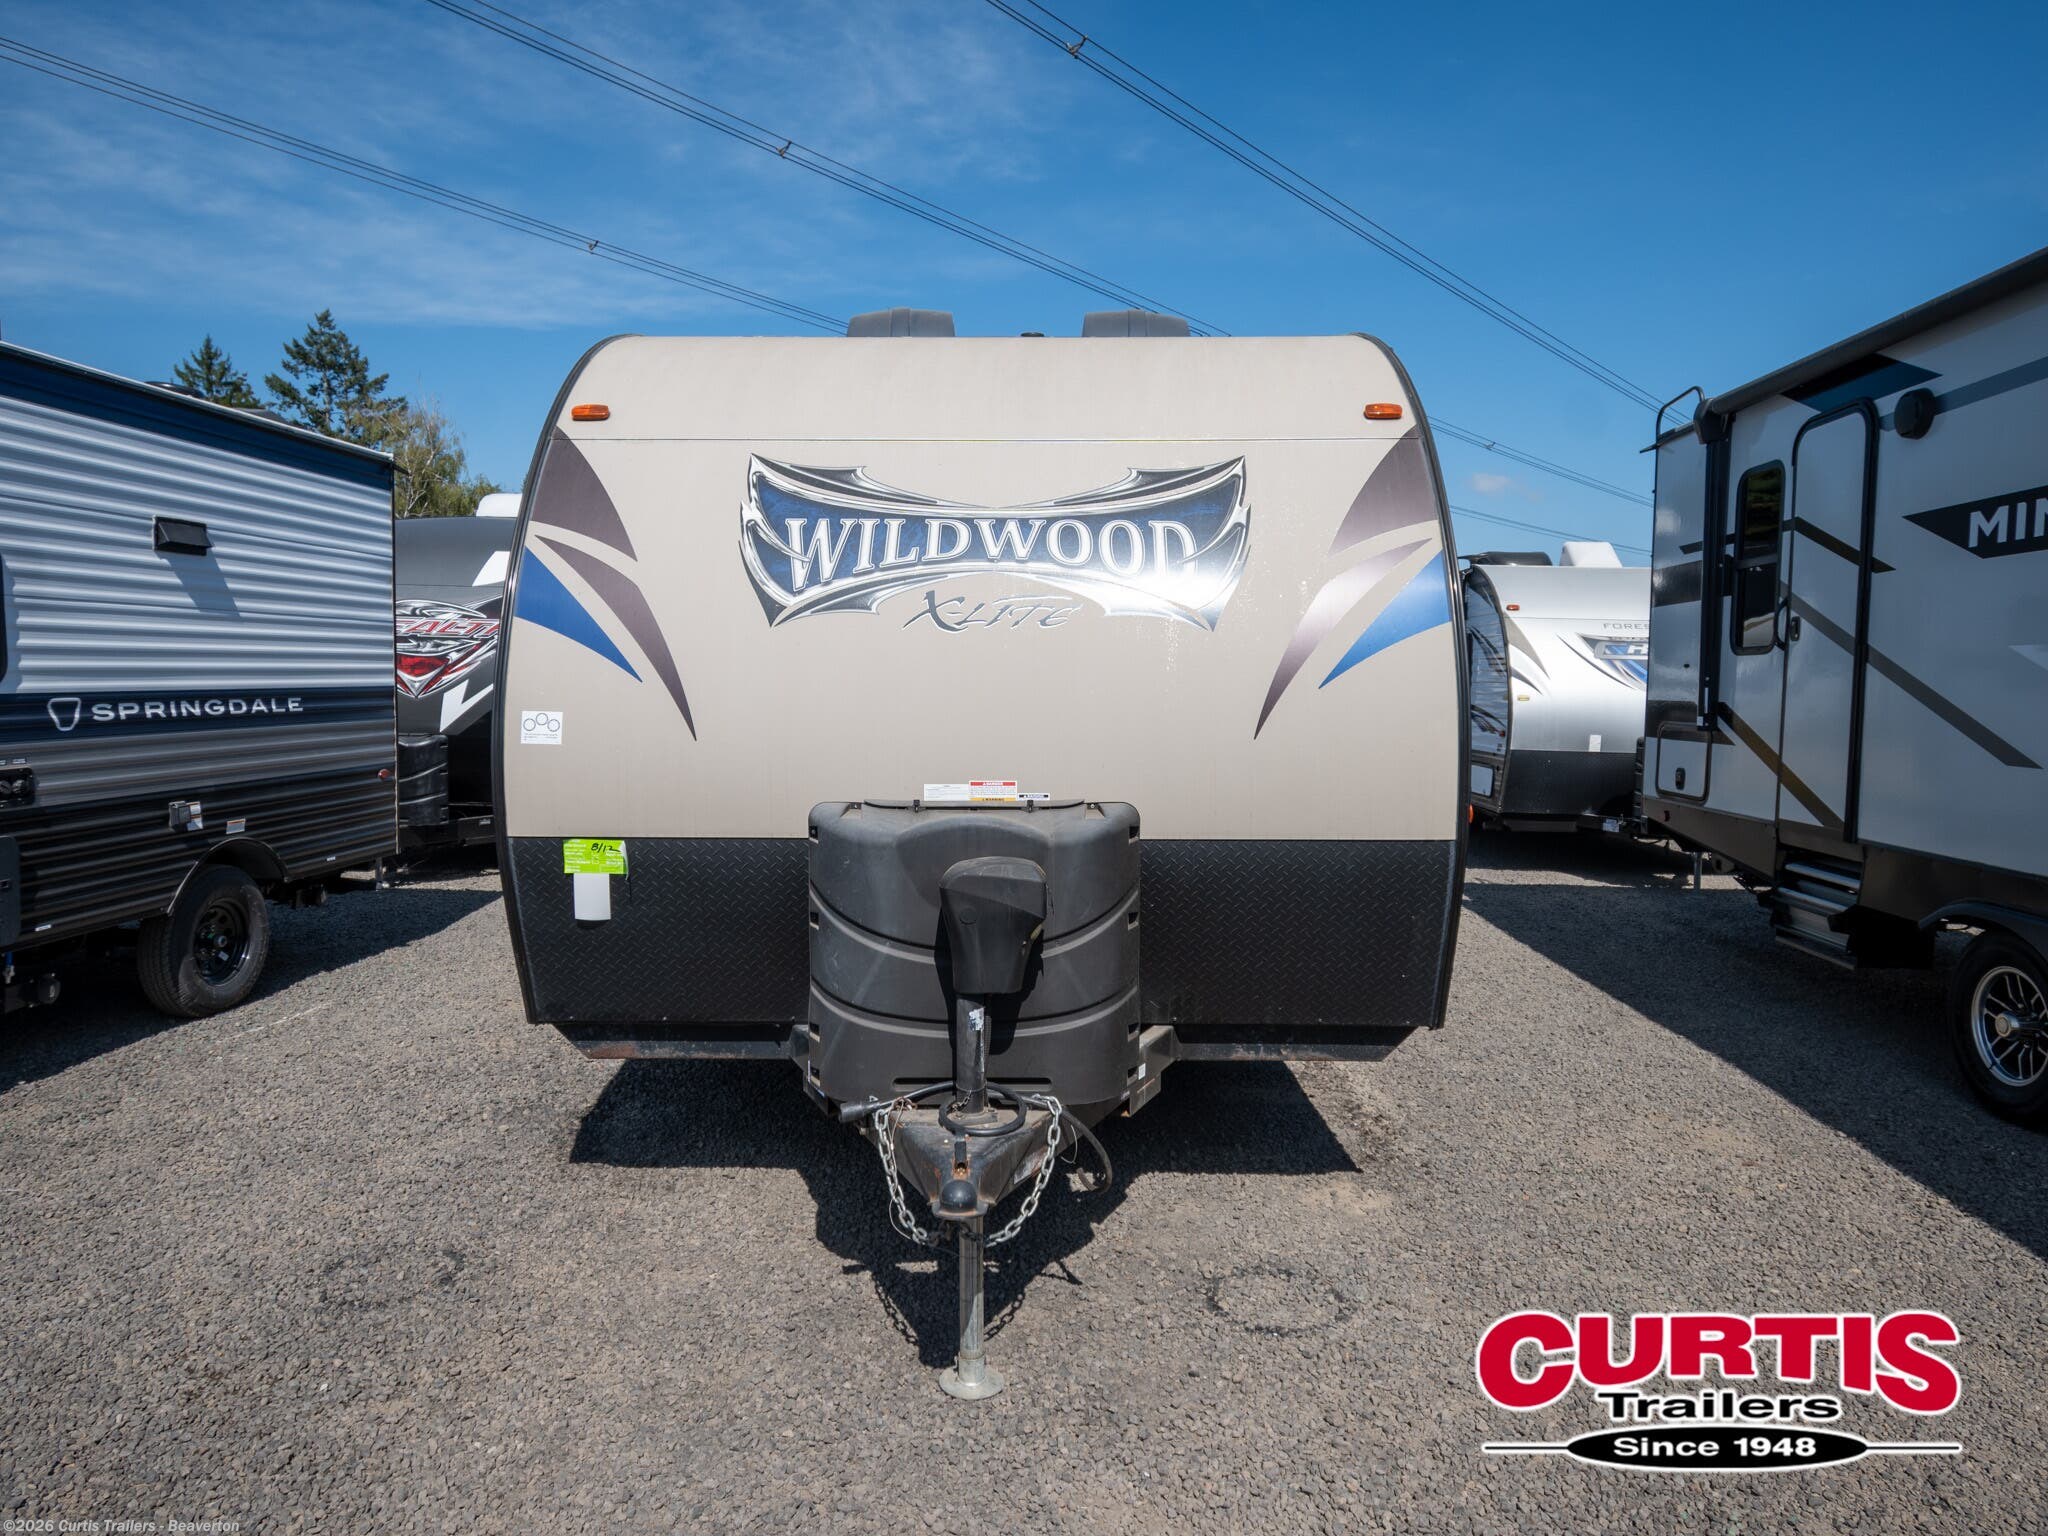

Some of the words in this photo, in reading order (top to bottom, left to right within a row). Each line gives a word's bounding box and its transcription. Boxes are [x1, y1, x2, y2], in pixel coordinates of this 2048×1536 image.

[784, 518, 1199, 593] WILDWOOD
[902, 590, 1083, 634] X-LITE
[91, 697, 304, 721] SPRINGDALE
